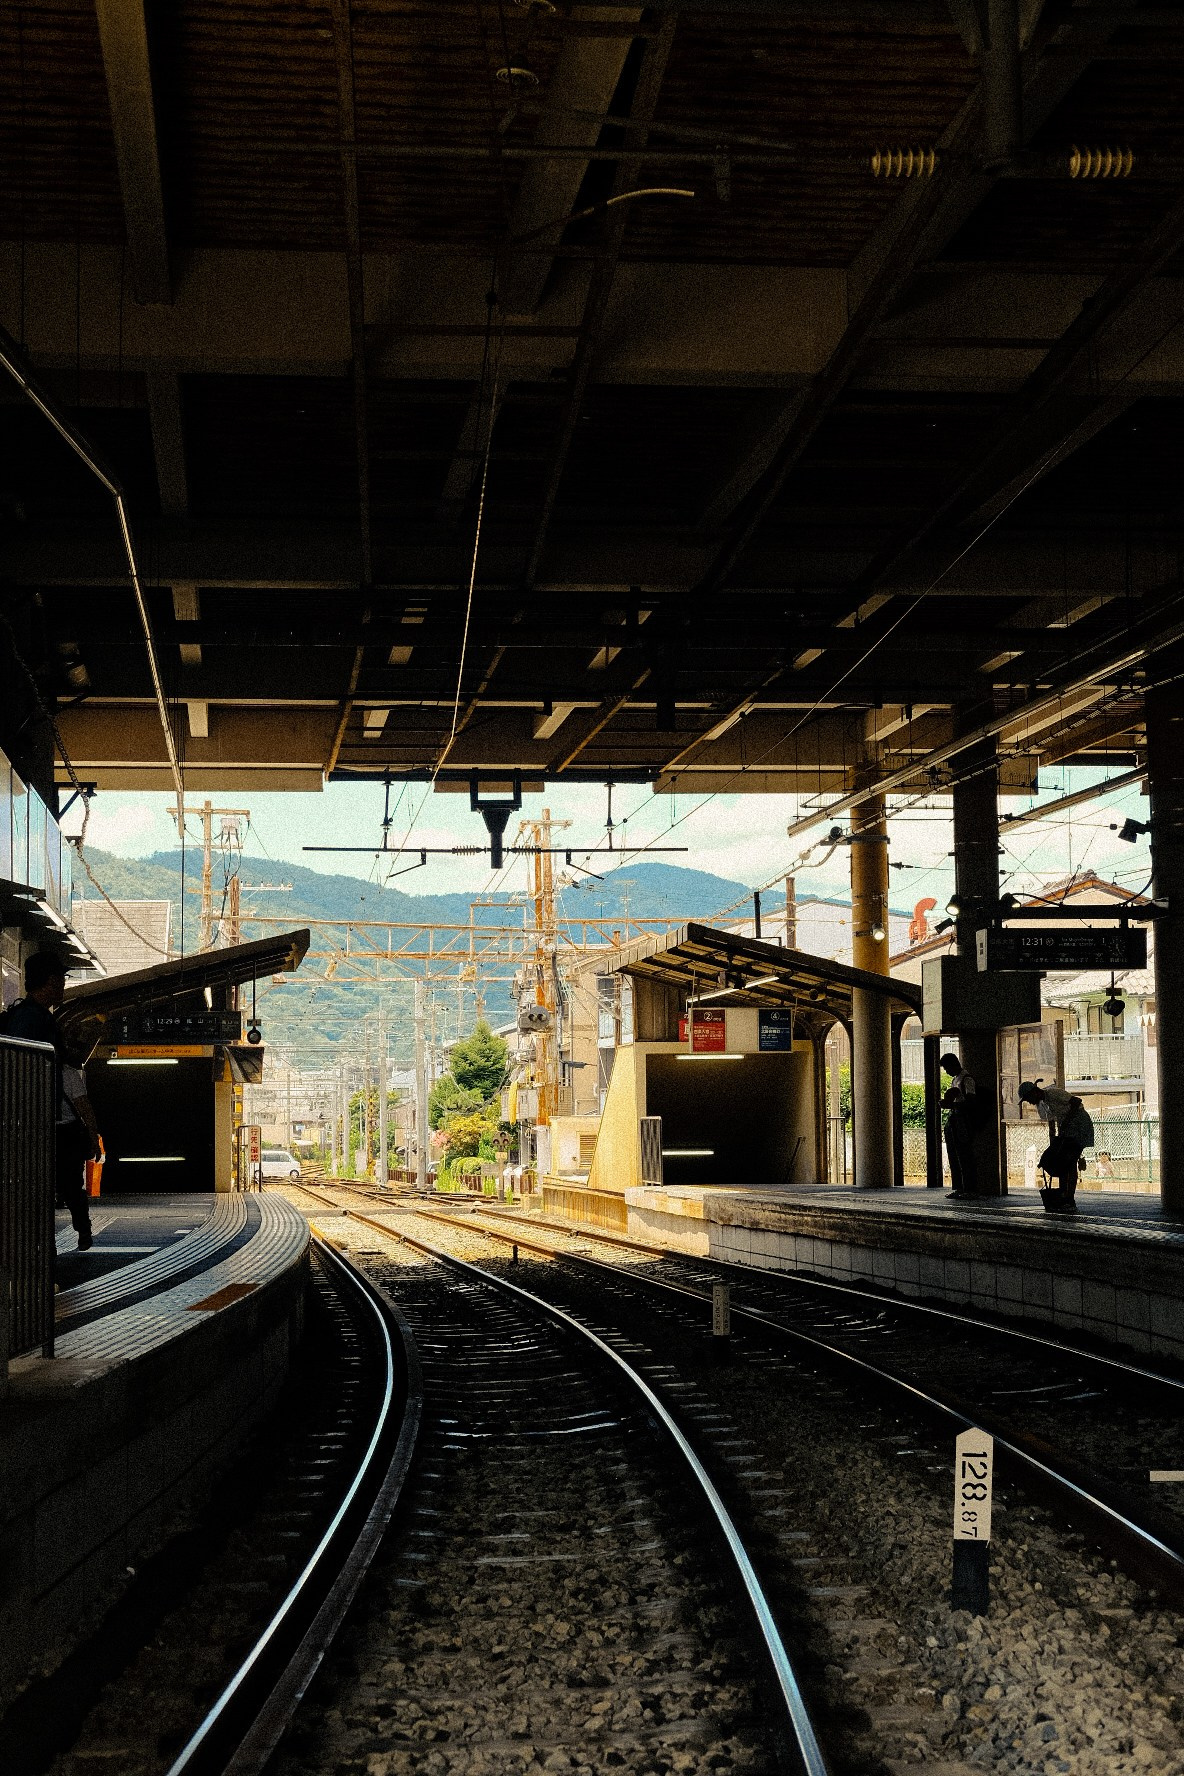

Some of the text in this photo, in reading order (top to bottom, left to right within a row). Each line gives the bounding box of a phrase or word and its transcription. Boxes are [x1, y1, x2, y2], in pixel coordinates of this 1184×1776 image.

[1021, 937, 1043, 946] 12:31
[250, 1128, 259, 1162] 行先確認
